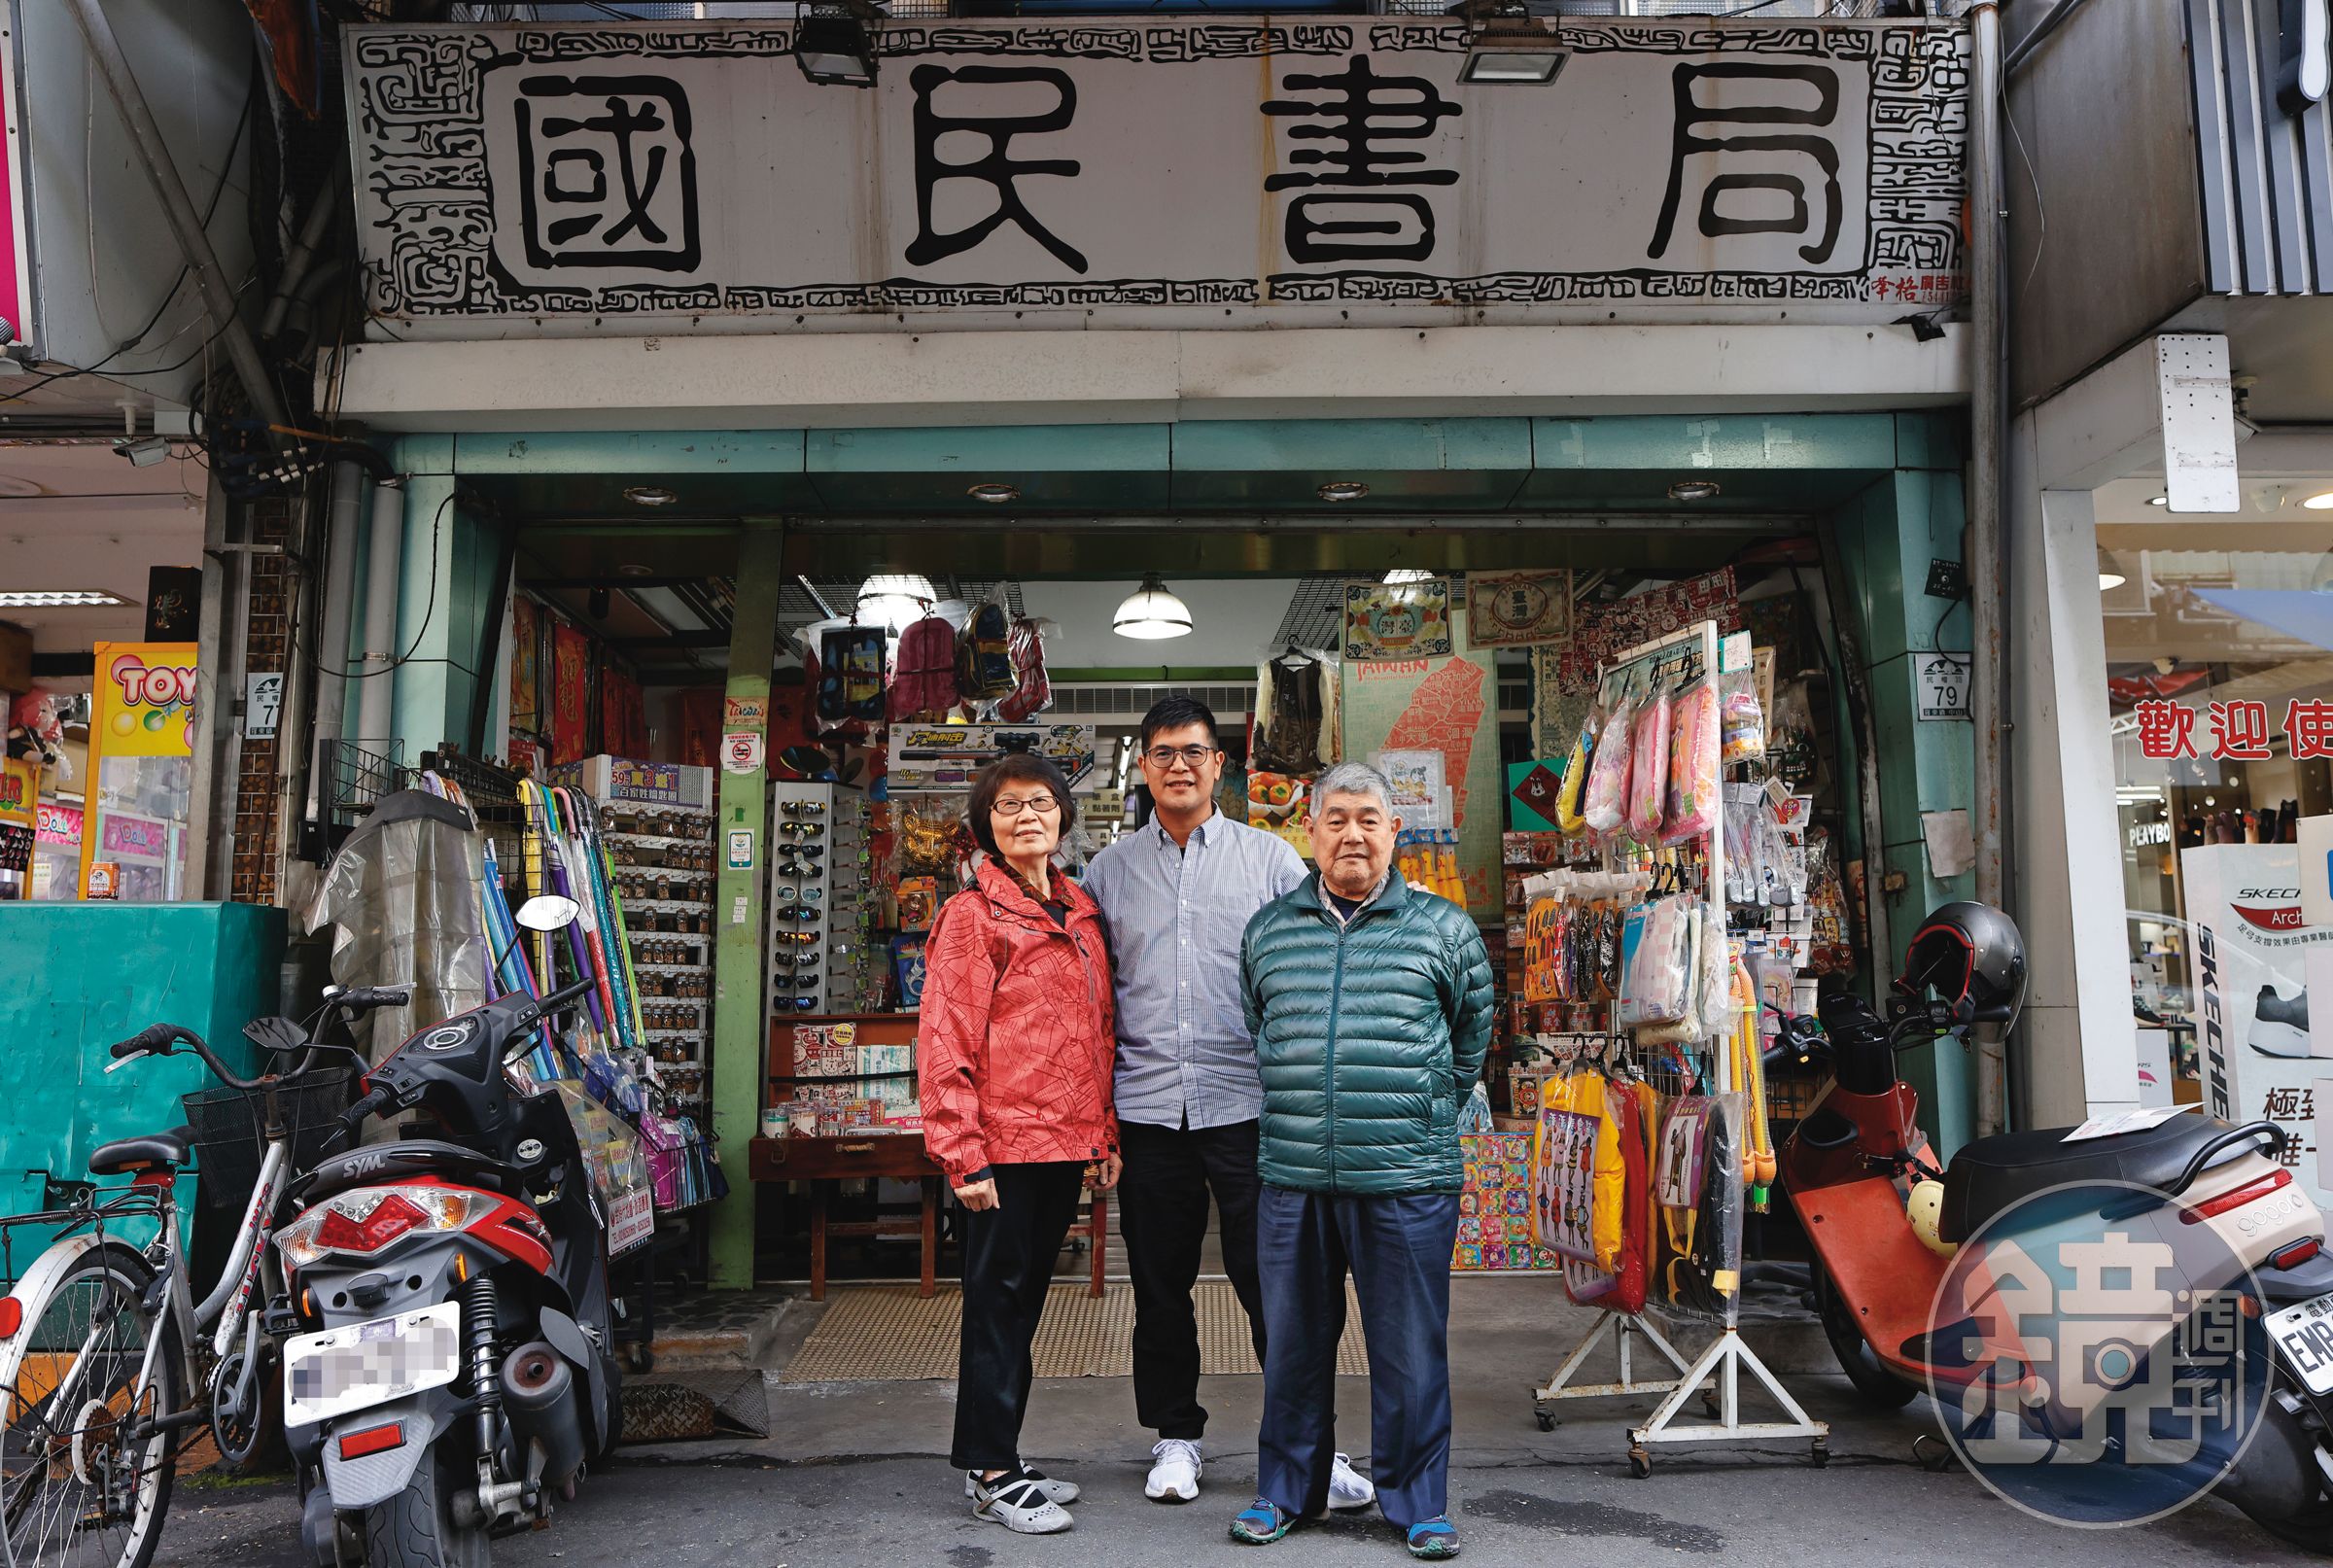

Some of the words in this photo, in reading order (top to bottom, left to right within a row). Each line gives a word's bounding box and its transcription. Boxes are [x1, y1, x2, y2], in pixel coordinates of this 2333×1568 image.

[514, 54, 1842, 273] 國民書局
[1933, 686, 1958, 706] 79
[263, 705, 279, 725] 7
[2197, 923, 2230, 1120] SKECHE
[343, 1154, 386, 1179] SYM
[2238, 1194, 2304, 1237] gogoro
[2305, 1294, 2333, 1318] 電動
